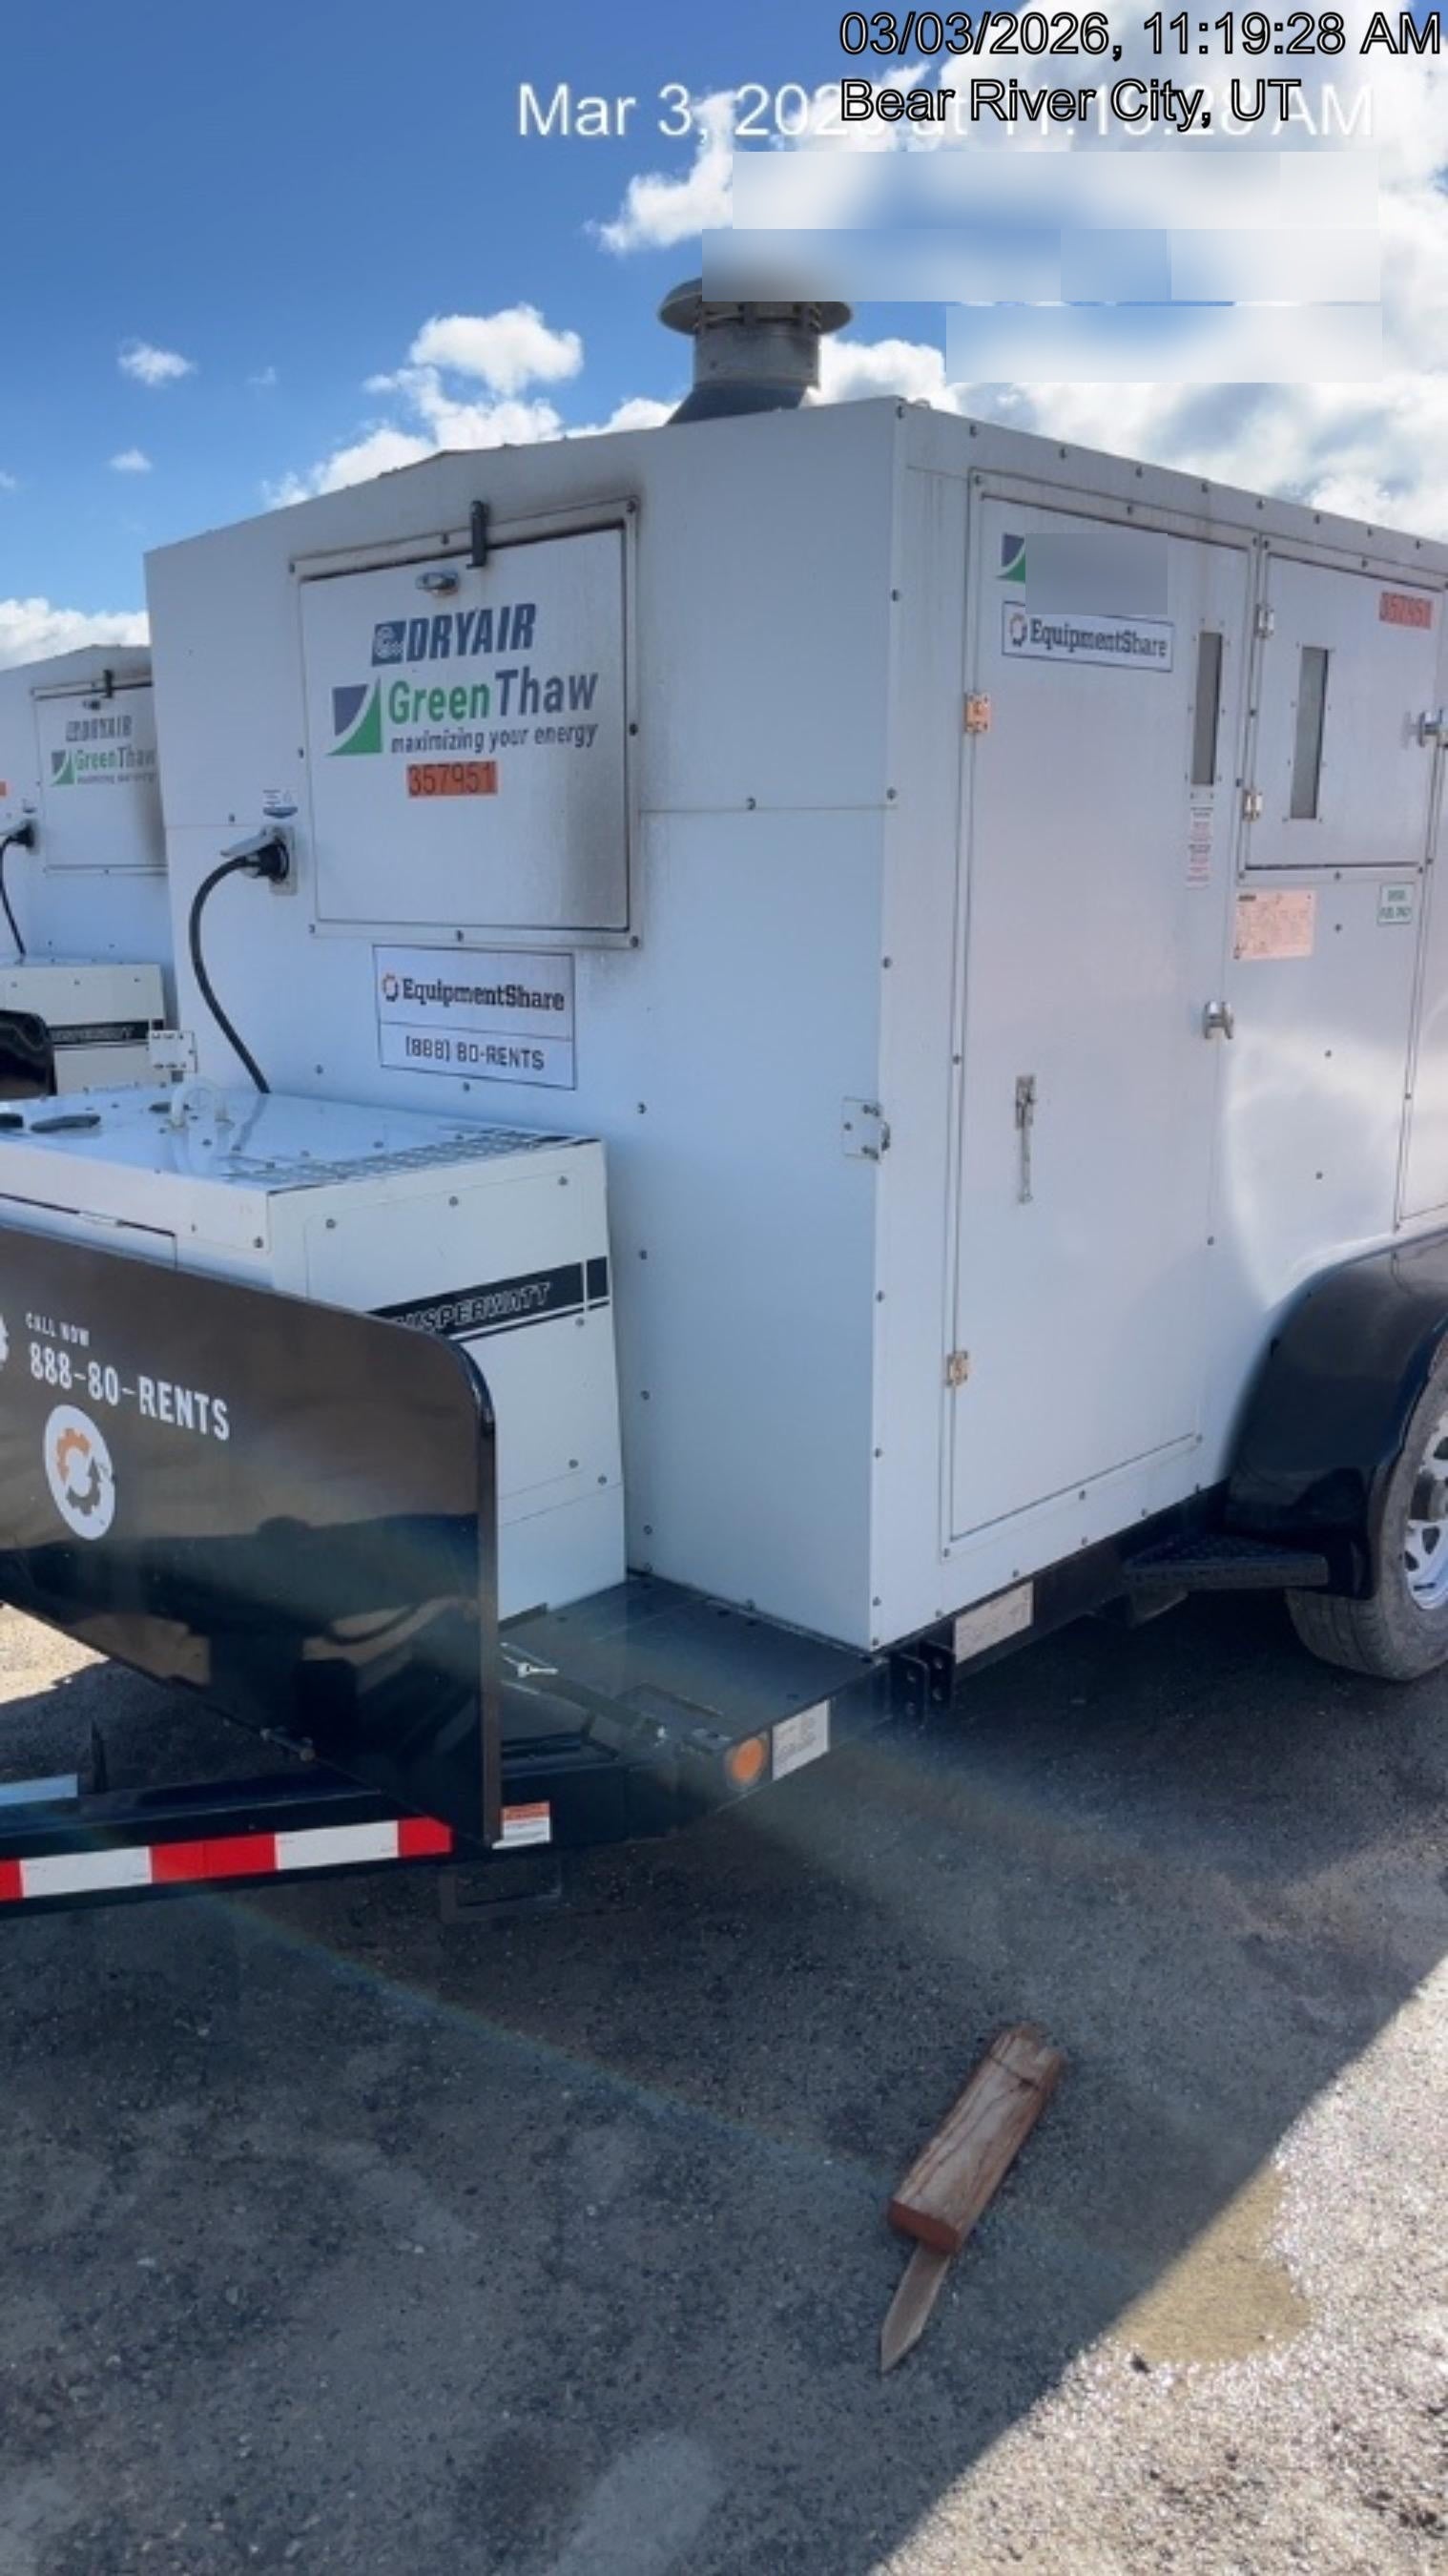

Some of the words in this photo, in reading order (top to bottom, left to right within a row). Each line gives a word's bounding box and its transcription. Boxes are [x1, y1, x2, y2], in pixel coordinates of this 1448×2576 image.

[405, 603, 536, 662] DRYAIR
[1029, 617, 1168, 658] EquipmentShare
[391, 727, 485, 755] maximizing
[488, 727, 529, 755] your
[534, 722, 599, 749] energy
[408, 760, 495, 796] 357951
[403, 977, 565, 1011] EquipmentShare
[457, 1041, 545, 1070] 80-RENTS
[26, 1312, 56, 1338] CALL
[59, 1321, 90, 1347] NOW
[30, 1341, 230, 1442] 888-80-RENTS
